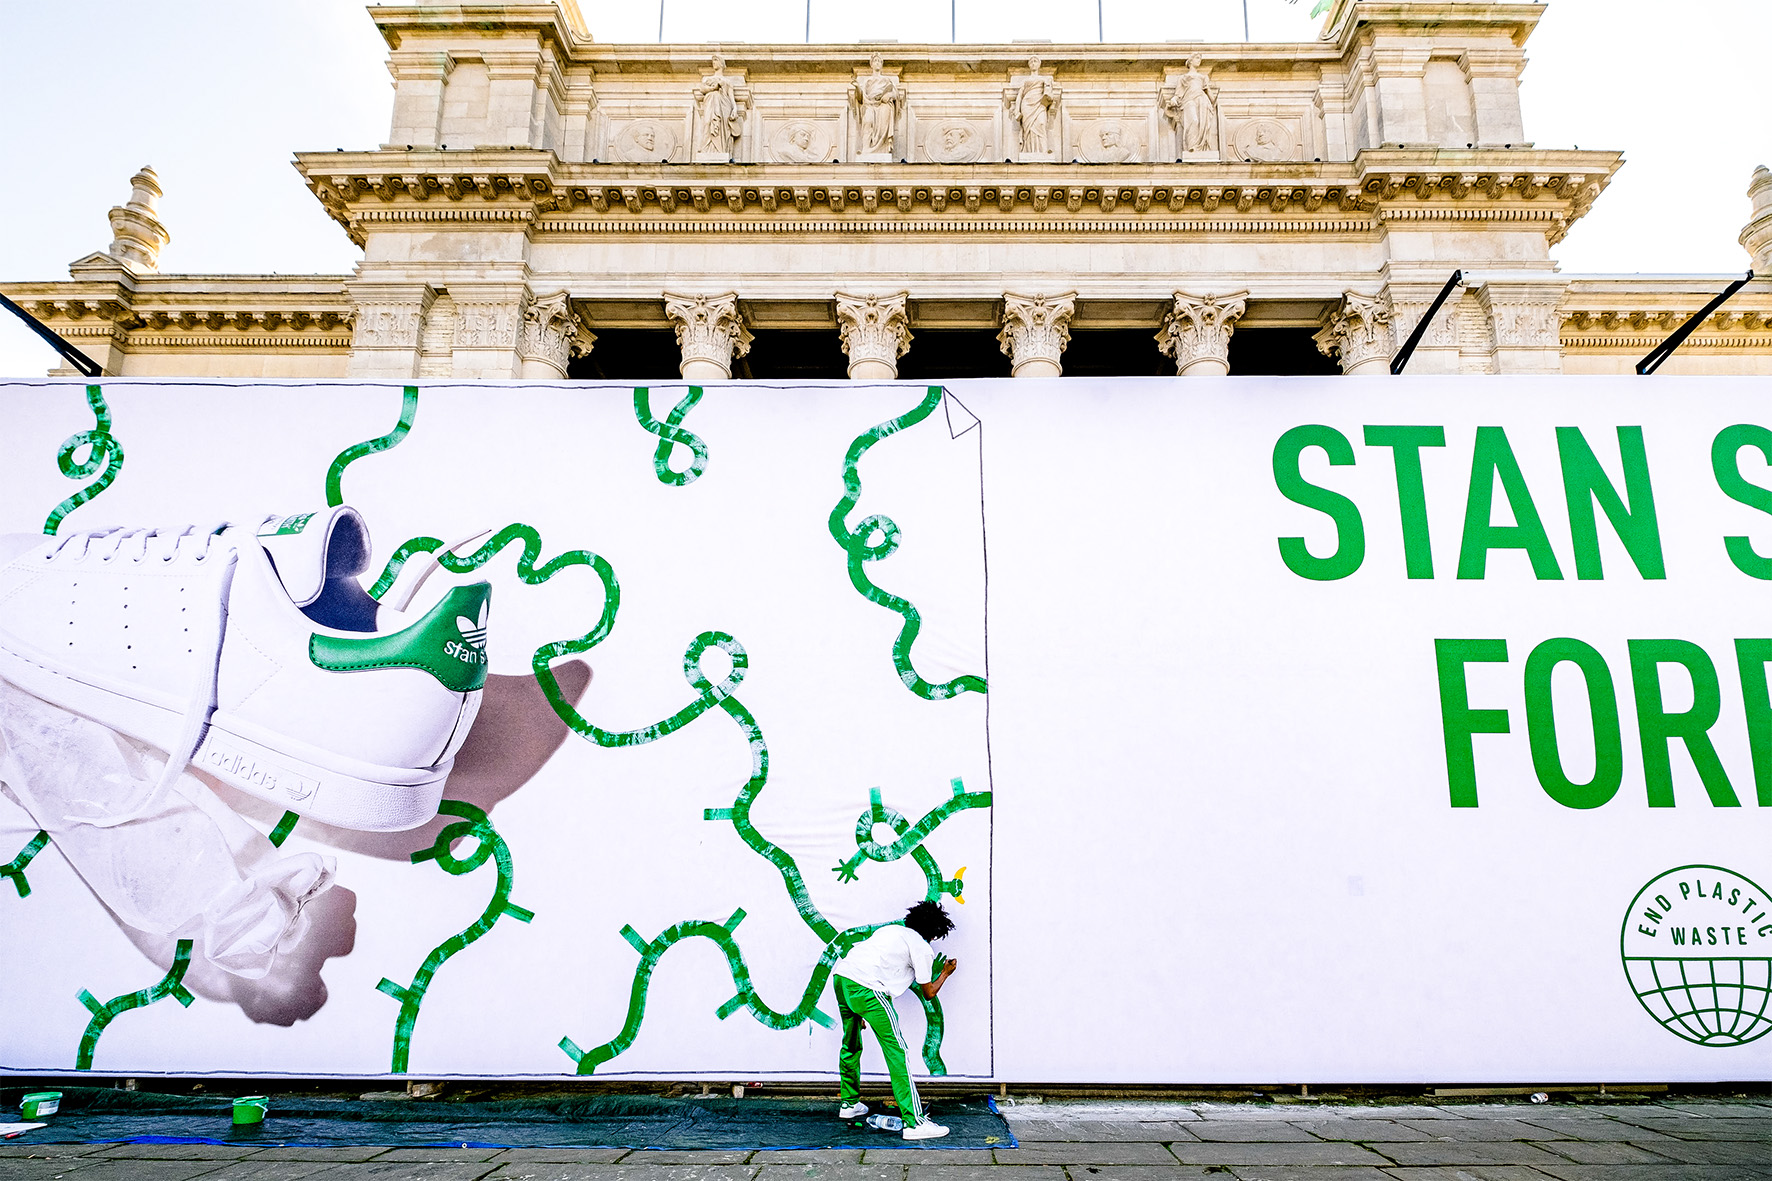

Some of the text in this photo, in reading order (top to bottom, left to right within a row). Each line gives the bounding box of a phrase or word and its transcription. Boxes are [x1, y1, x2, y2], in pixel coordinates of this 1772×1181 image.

[1273, 424, 1667, 582] STAN
[444, 640, 477, 664] stan
[211, 752, 278, 790] adidas
[1638, 879, 1772, 938] END PLASTIC
[1670, 926, 1748, 946] WASTE
